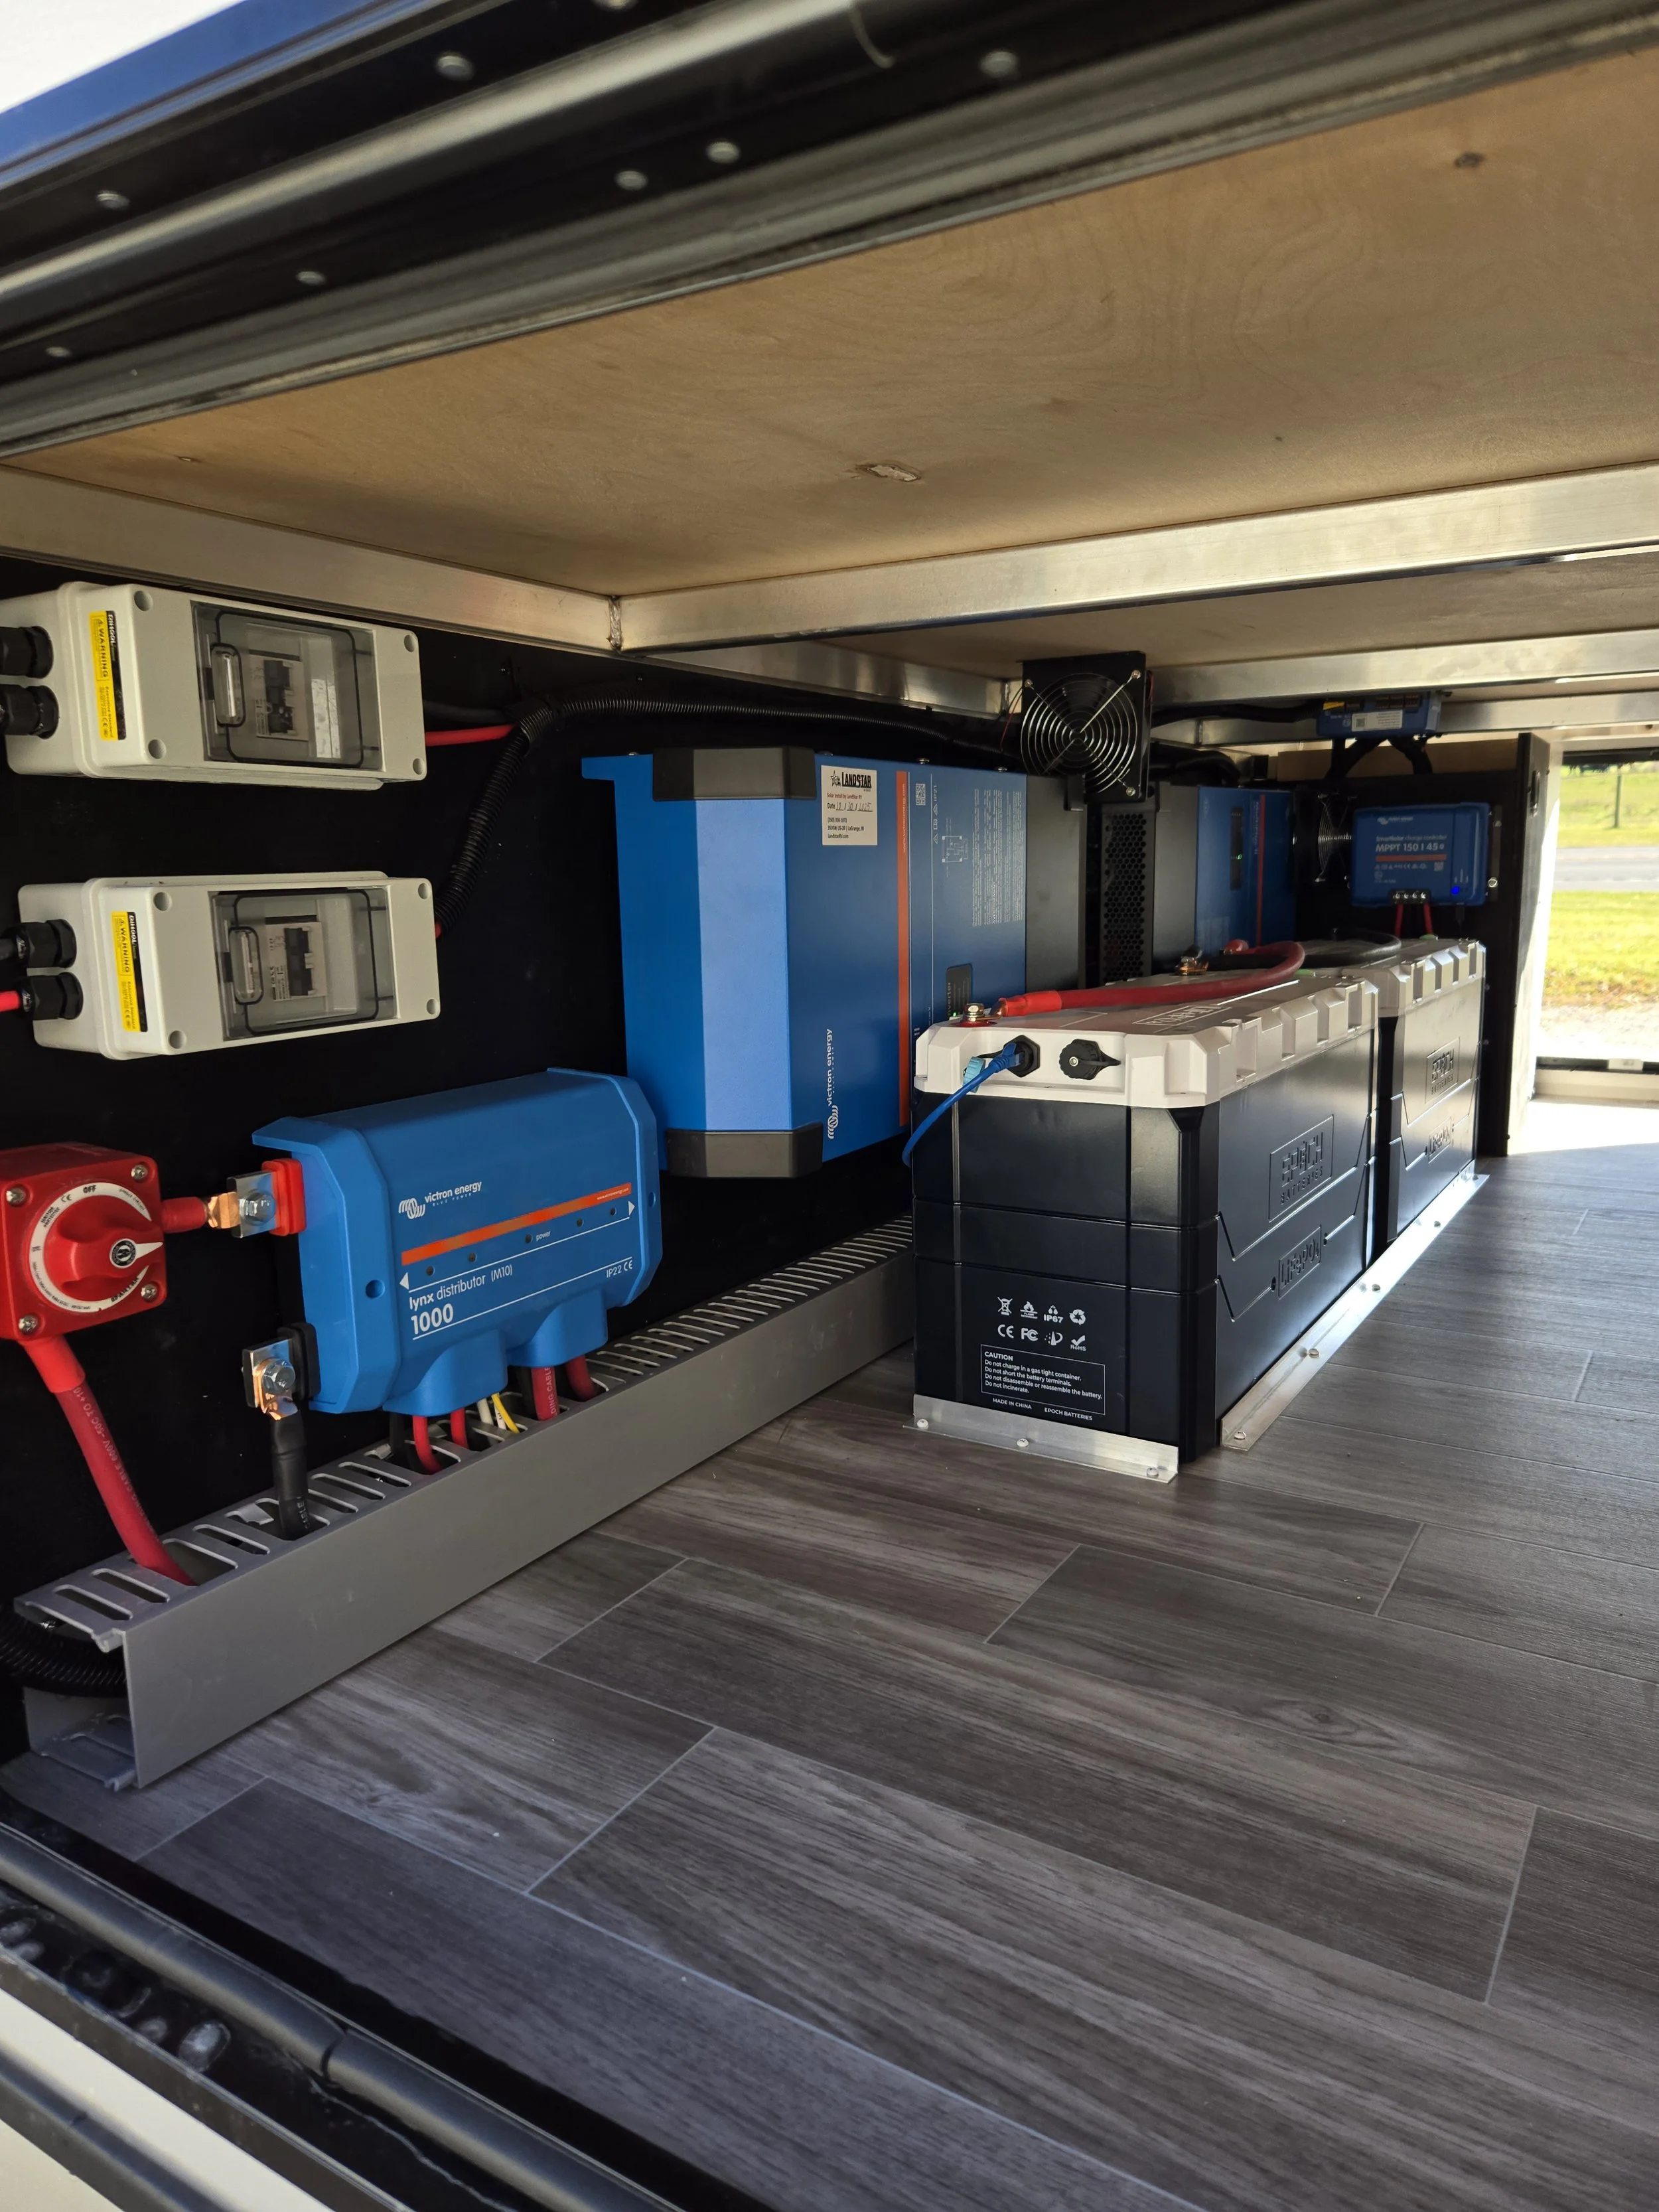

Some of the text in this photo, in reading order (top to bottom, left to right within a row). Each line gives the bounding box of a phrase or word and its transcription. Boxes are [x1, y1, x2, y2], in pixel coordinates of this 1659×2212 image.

[99, 628, 108, 678] WARNING
[841, 772, 872, 788] LANDSTAR
[1376, 844, 1400, 852] MPPT
[1403, 843, 1419, 851] 150
[1426, 842, 1438, 851] 45
[119, 927, 129, 973] WARNING
[1431, 1073, 1453, 1096] BATTERIES
[1281, 1132, 1324, 1188] EPOCH
[83, 1185, 97, 1193] OFF
[425, 1181, 482, 1204] victron energy
[1280, 1166, 1323, 1205] BATTERIES
[536, 1230, 551, 1242] power
[607, 1265, 622, 1278] IP22
[409, 1264, 513, 1311] lynx distributor (M10)
[411, 1303, 454, 1335] 1000
[1043, 1314, 1064, 1323] IP67
[997, 1324, 1015, 1339] CE
[984, 1351, 1013, 1361] CAUTION
[1002, 1363, 1020, 1371] charge
[1055, 1372, 1082, 1381] container.
[1027, 1373, 1045, 1383] battery
[1045, 1377, 1072, 1386] terminals.
[1003, 1376, 1033, 1388] disassemble
[1041, 1384, 1071, 1394] reassemble
[1082, 1390, 1102, 1400] battery.
[1003, 1383, 1029, 1393] incinerate.
[83, 1403, 95, 1417] TO
[1044, 1407, 1093, 1421] EPOCH BATTERIES
[102, 1439, 118, 1461] 600V
[115, 1463, 133, 1492] CABLE
